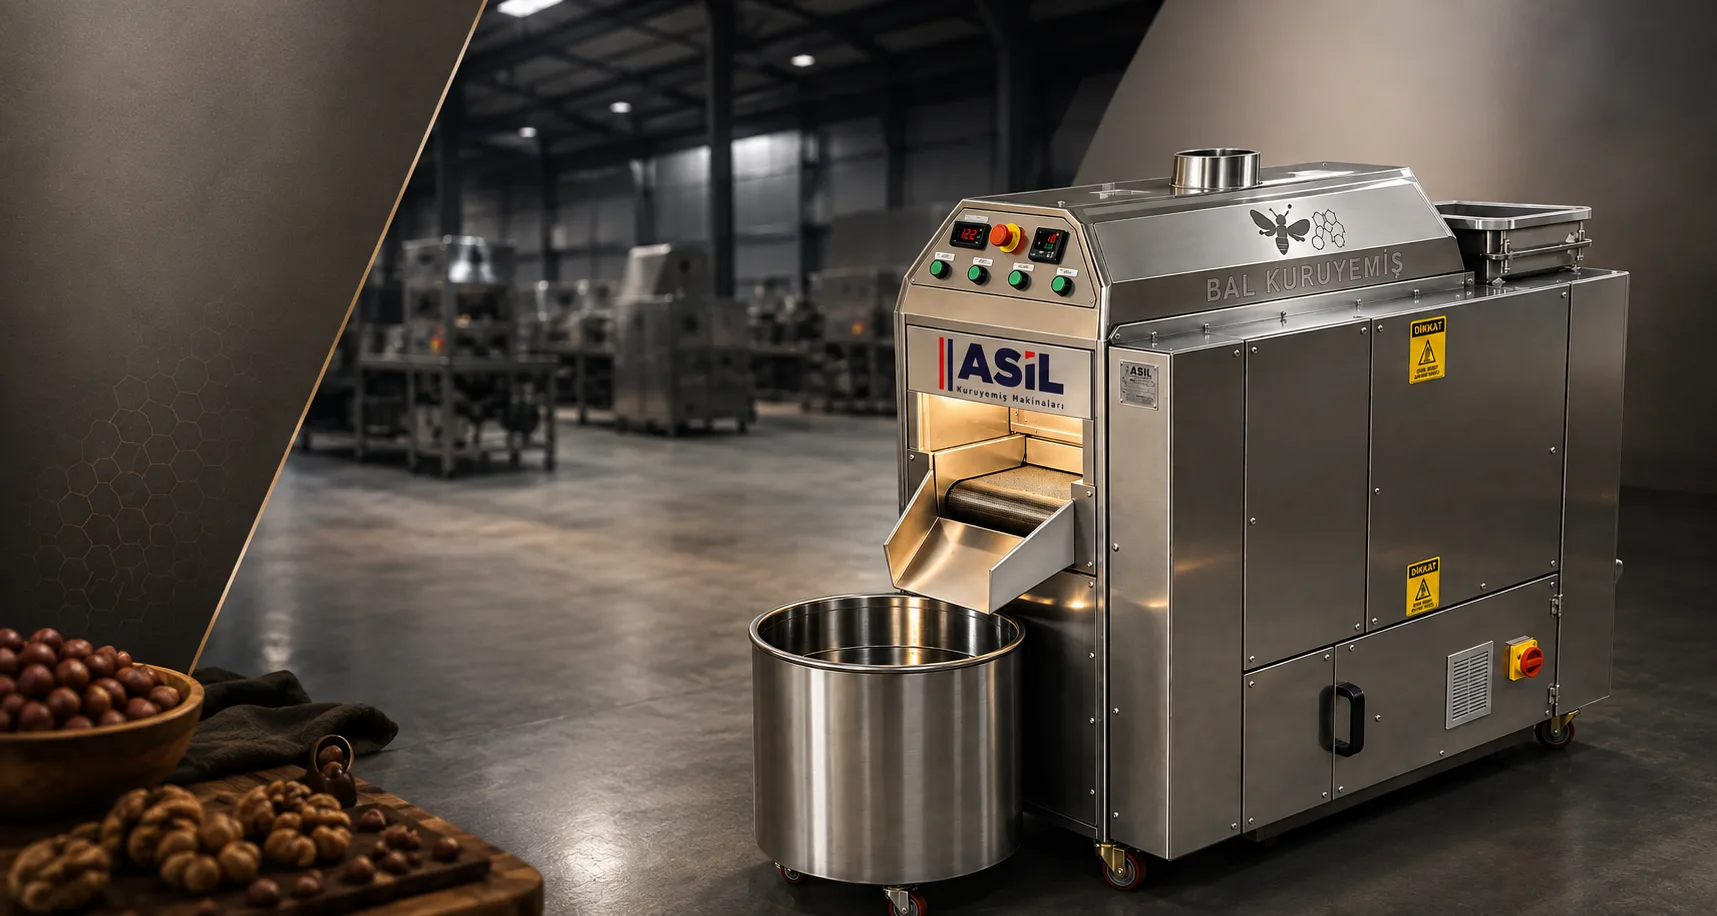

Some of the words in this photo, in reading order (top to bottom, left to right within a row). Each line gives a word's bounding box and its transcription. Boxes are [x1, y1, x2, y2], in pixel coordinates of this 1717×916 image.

[961, 229, 977, 240] 122
[1206, 274, 1256, 301] BAL
[1266, 249, 1404, 293] KURUYEMİŞ
[956, 386, 1008, 402] Kuruyemiş
[1012, 394, 1064, 410] Makinaları
